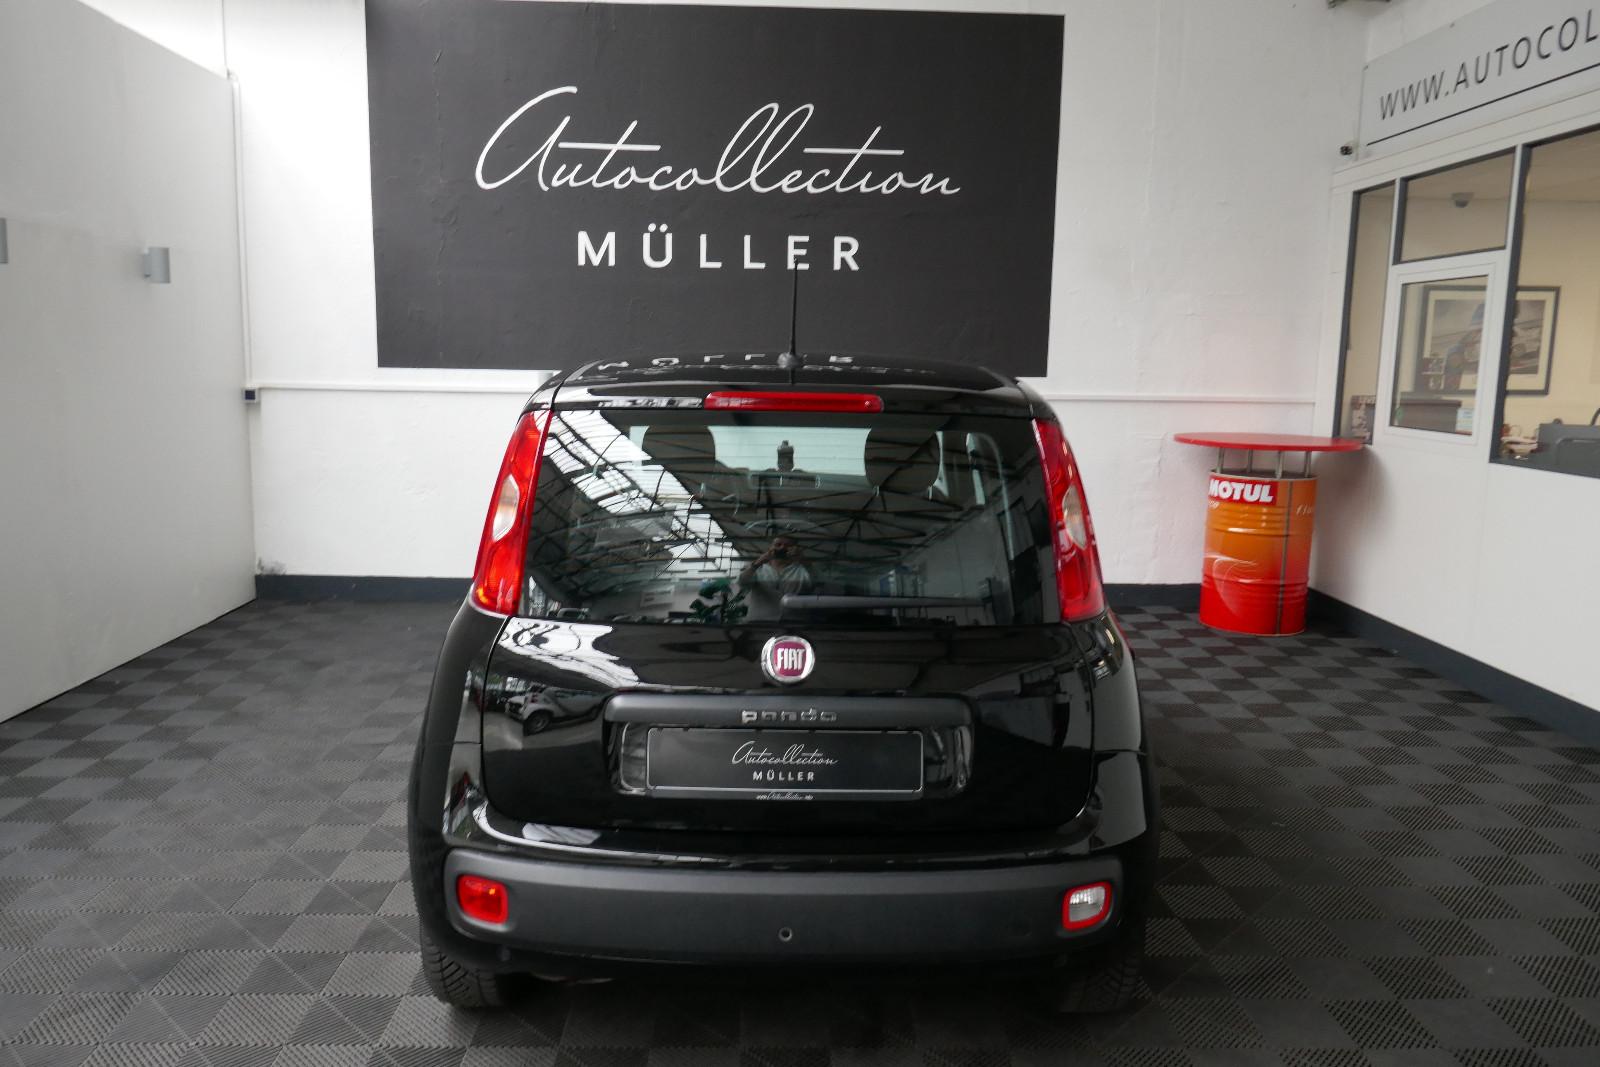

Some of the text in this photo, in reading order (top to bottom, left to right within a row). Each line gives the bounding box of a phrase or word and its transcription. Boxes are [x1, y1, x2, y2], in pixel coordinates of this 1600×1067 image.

[1380, 9, 1599, 120] WWW.AUTOCOL
[475, 86, 961, 194] Autocollection
[577, 223, 860, 270] MÜLLER
[1208, 479, 1273, 503] MOTUL
[777, 648, 805, 670] FIAT
[731, 740, 838, 765] Autocollection
[752, 769, 815, 781] MÜLLER
